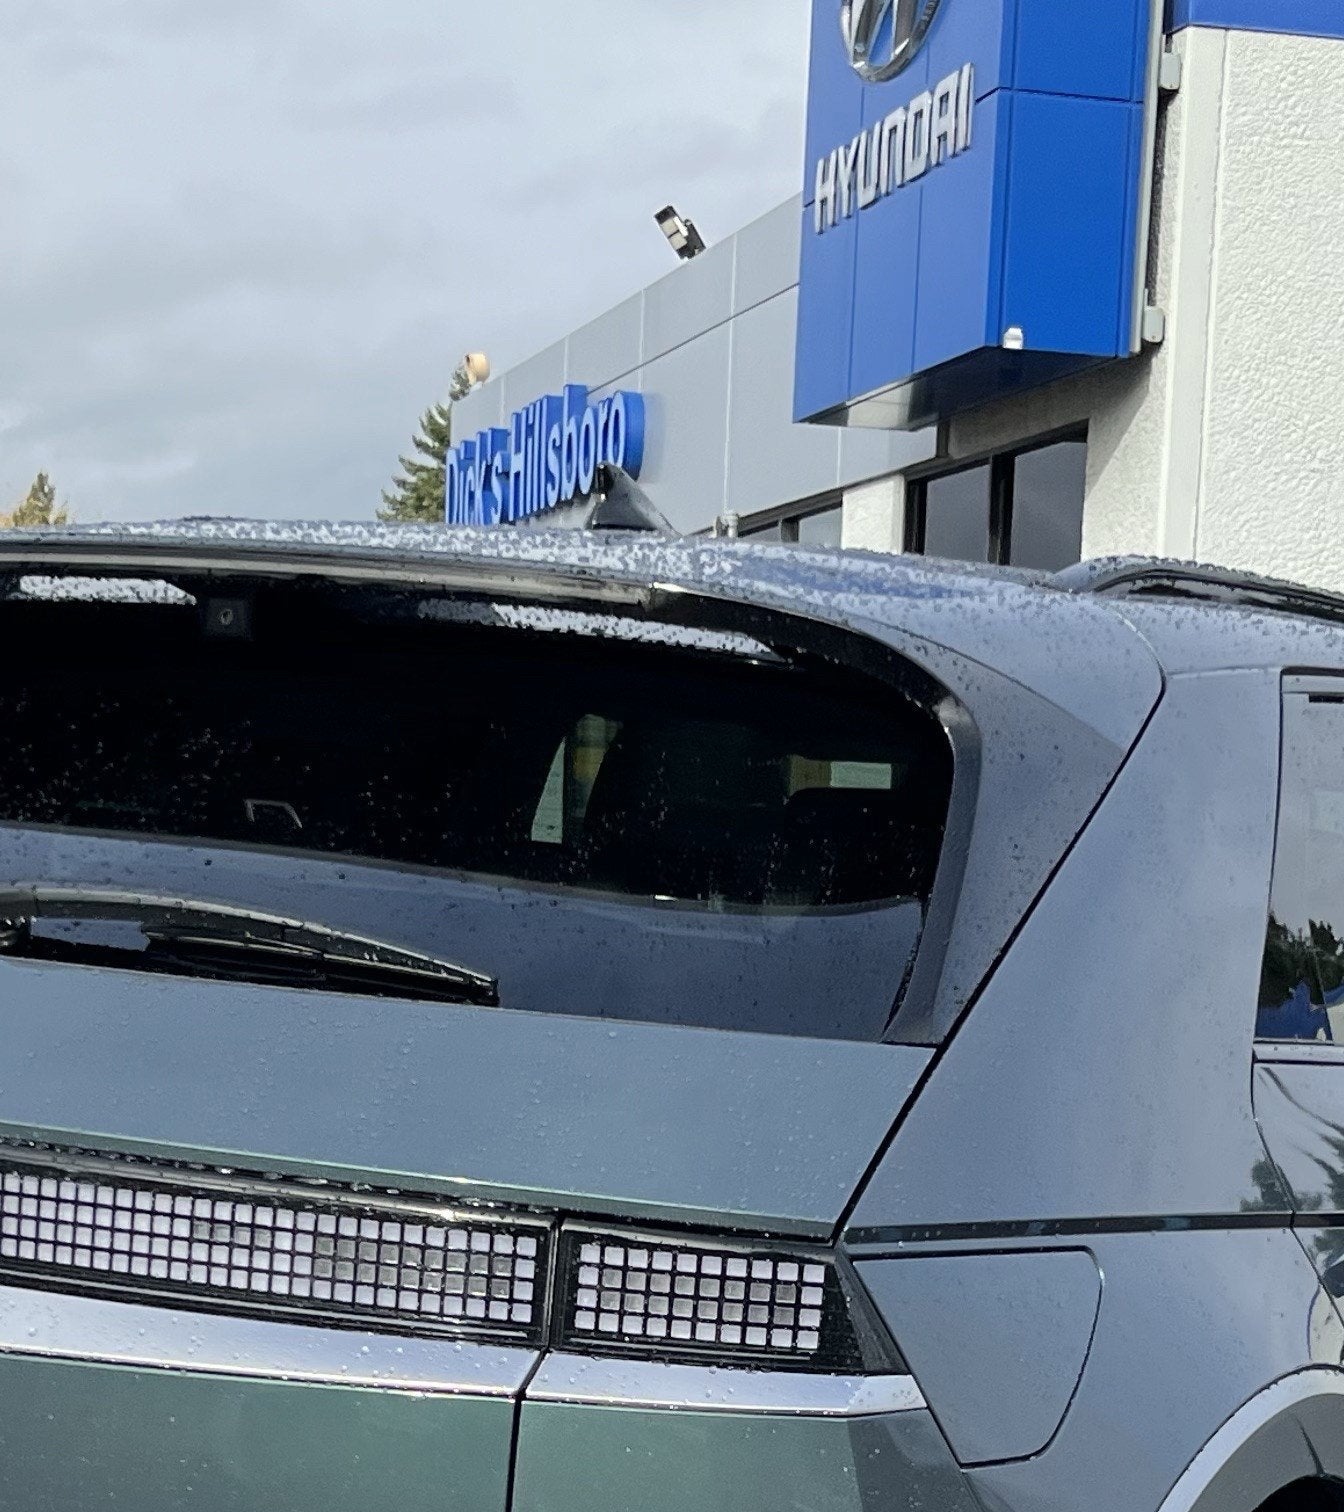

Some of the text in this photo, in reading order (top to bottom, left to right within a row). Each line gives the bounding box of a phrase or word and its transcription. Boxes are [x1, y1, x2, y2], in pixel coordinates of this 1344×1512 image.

[814, 62, 975, 235] HYUNDAI
[445, 383, 632, 526] Dick's Hillsboro
